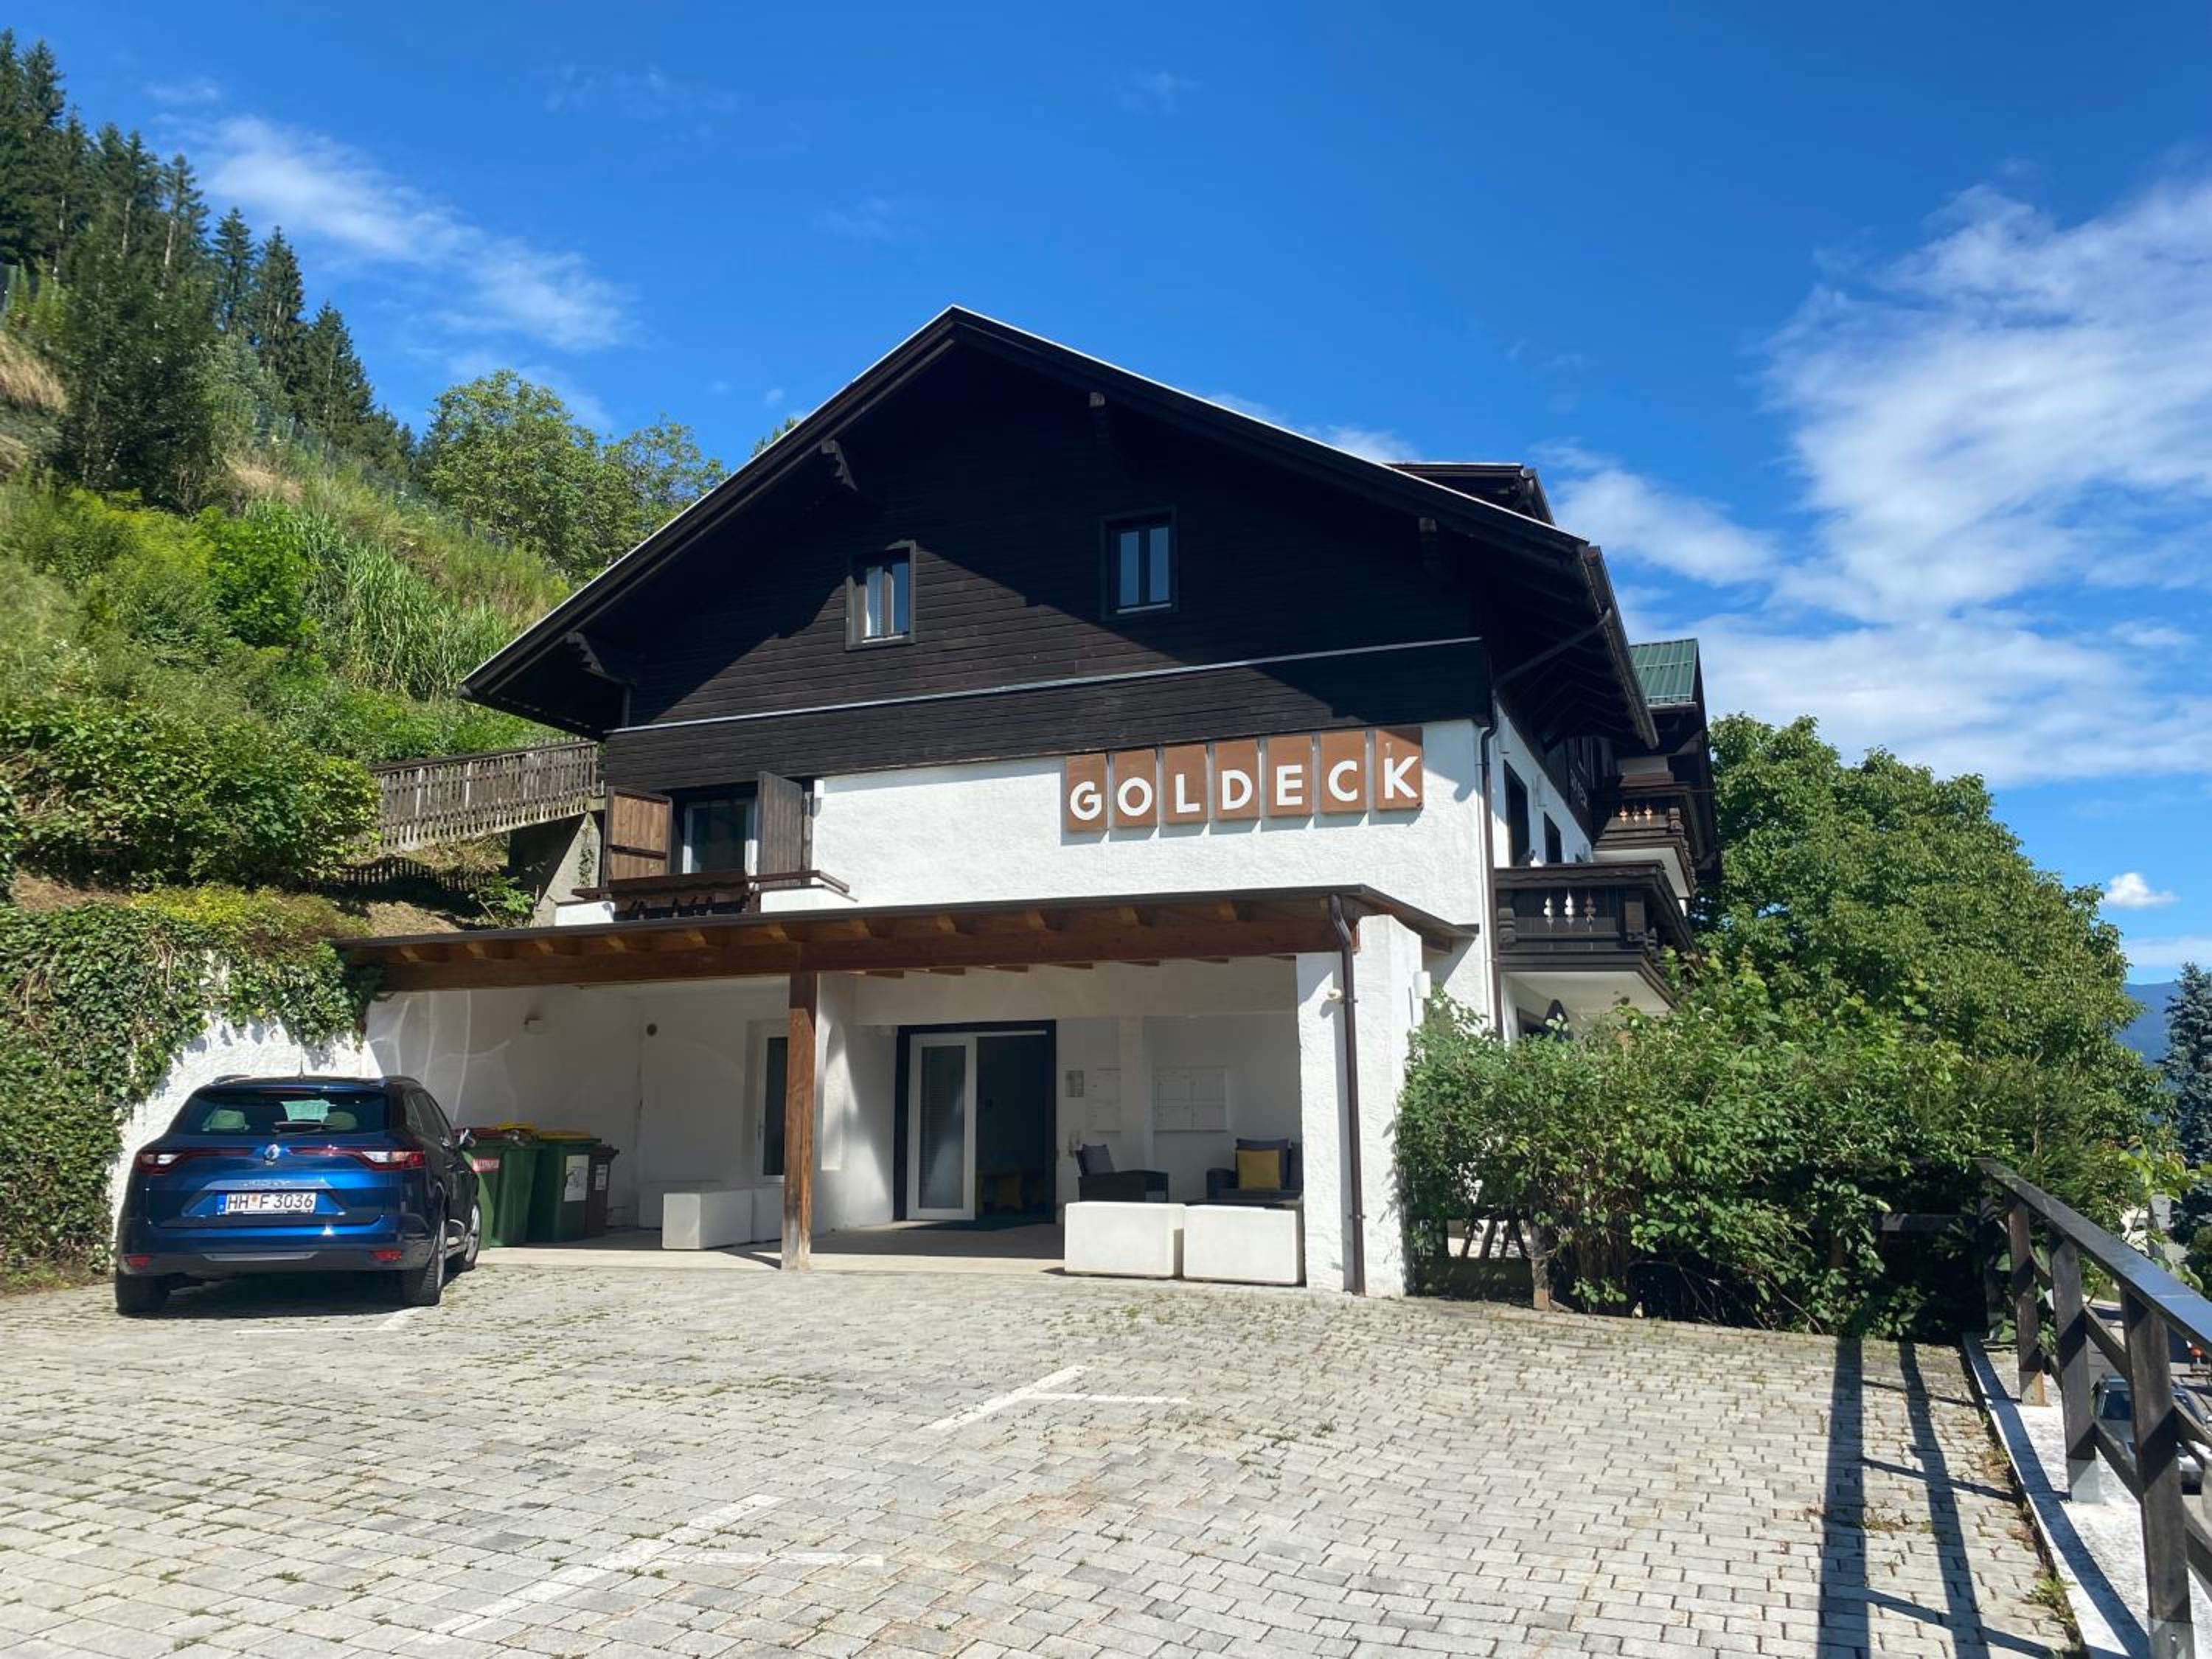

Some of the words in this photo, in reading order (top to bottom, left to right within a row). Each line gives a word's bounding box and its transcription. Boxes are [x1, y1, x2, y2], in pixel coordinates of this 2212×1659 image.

[1070, 756, 1419, 821] GOLDECK
[228, 1194, 248, 1210] HH
[274, 1194, 313, 1208] 3036
